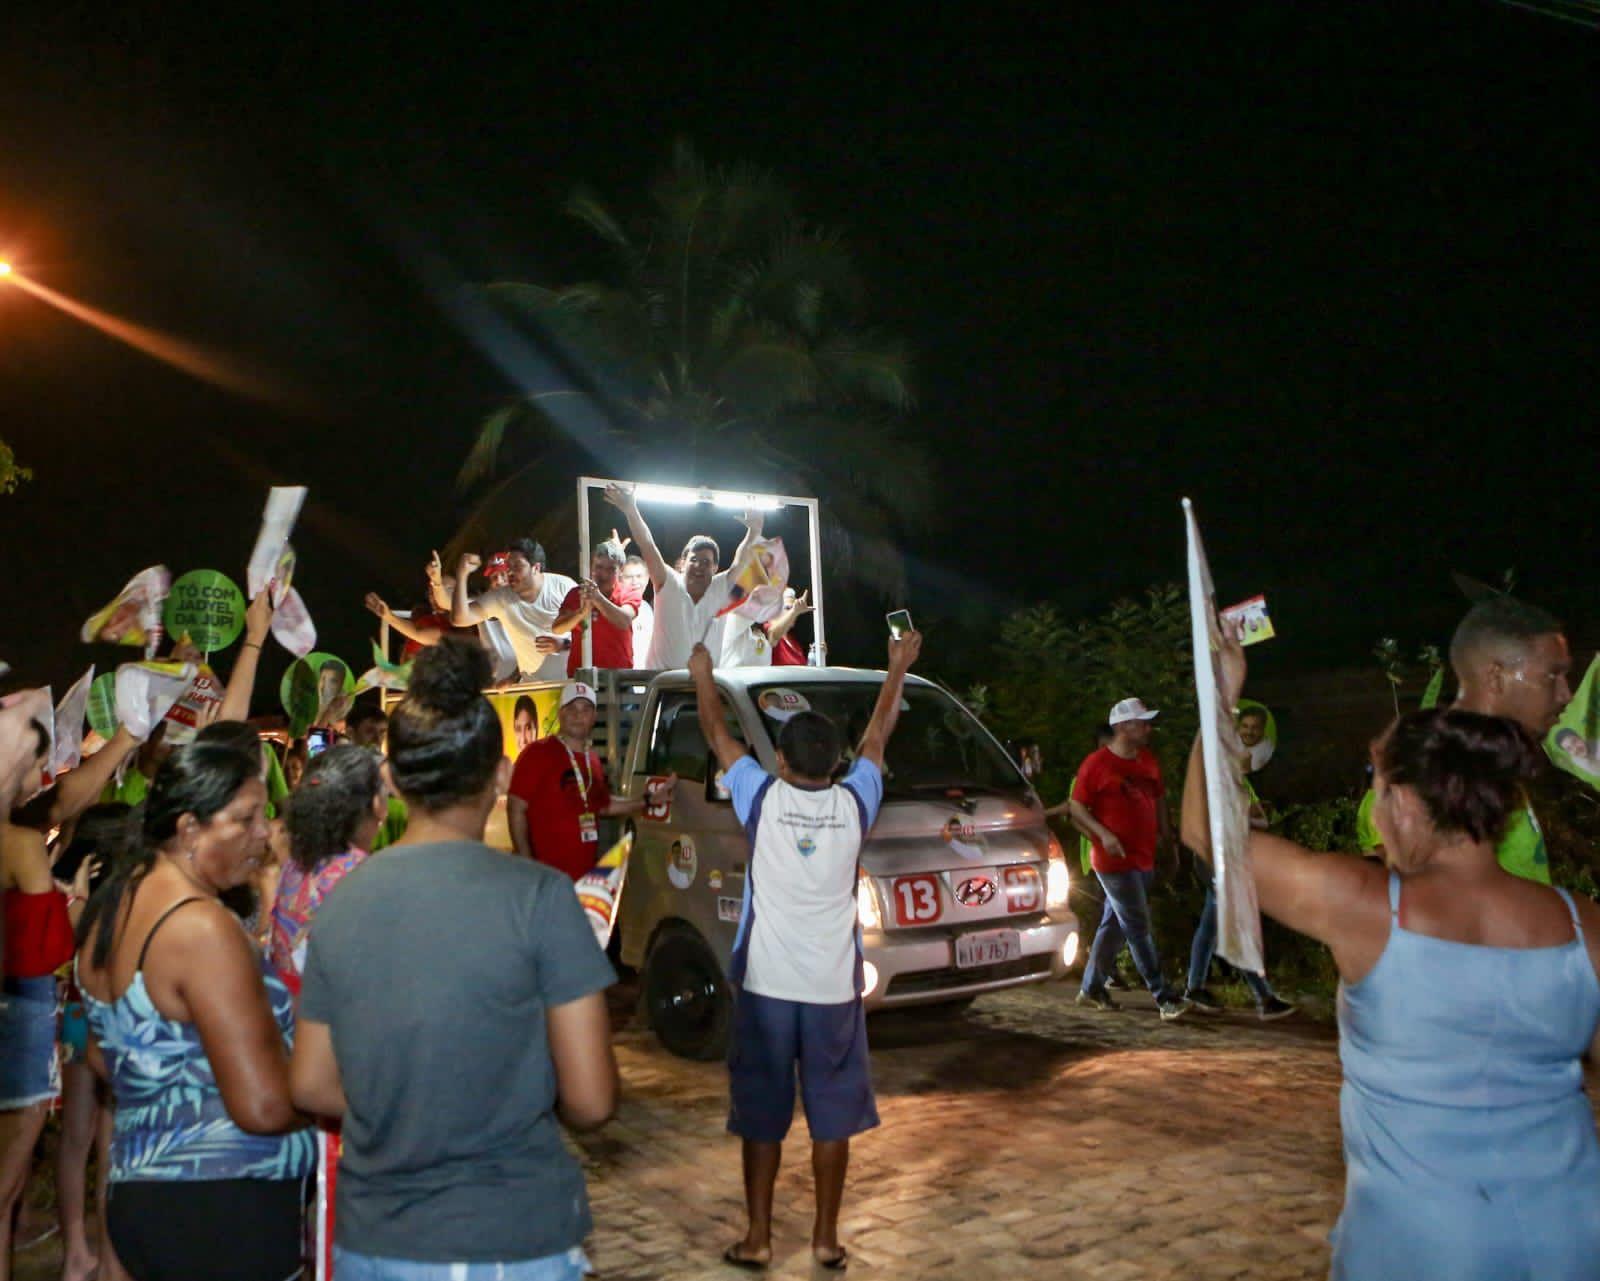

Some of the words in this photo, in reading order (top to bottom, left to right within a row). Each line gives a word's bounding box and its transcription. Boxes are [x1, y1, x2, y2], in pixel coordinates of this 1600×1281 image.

[203, 586, 236, 600] COM
[176, 600, 233, 614] JADYEL
[175, 614, 197, 624] DA
[898, 880, 939, 921] 13
